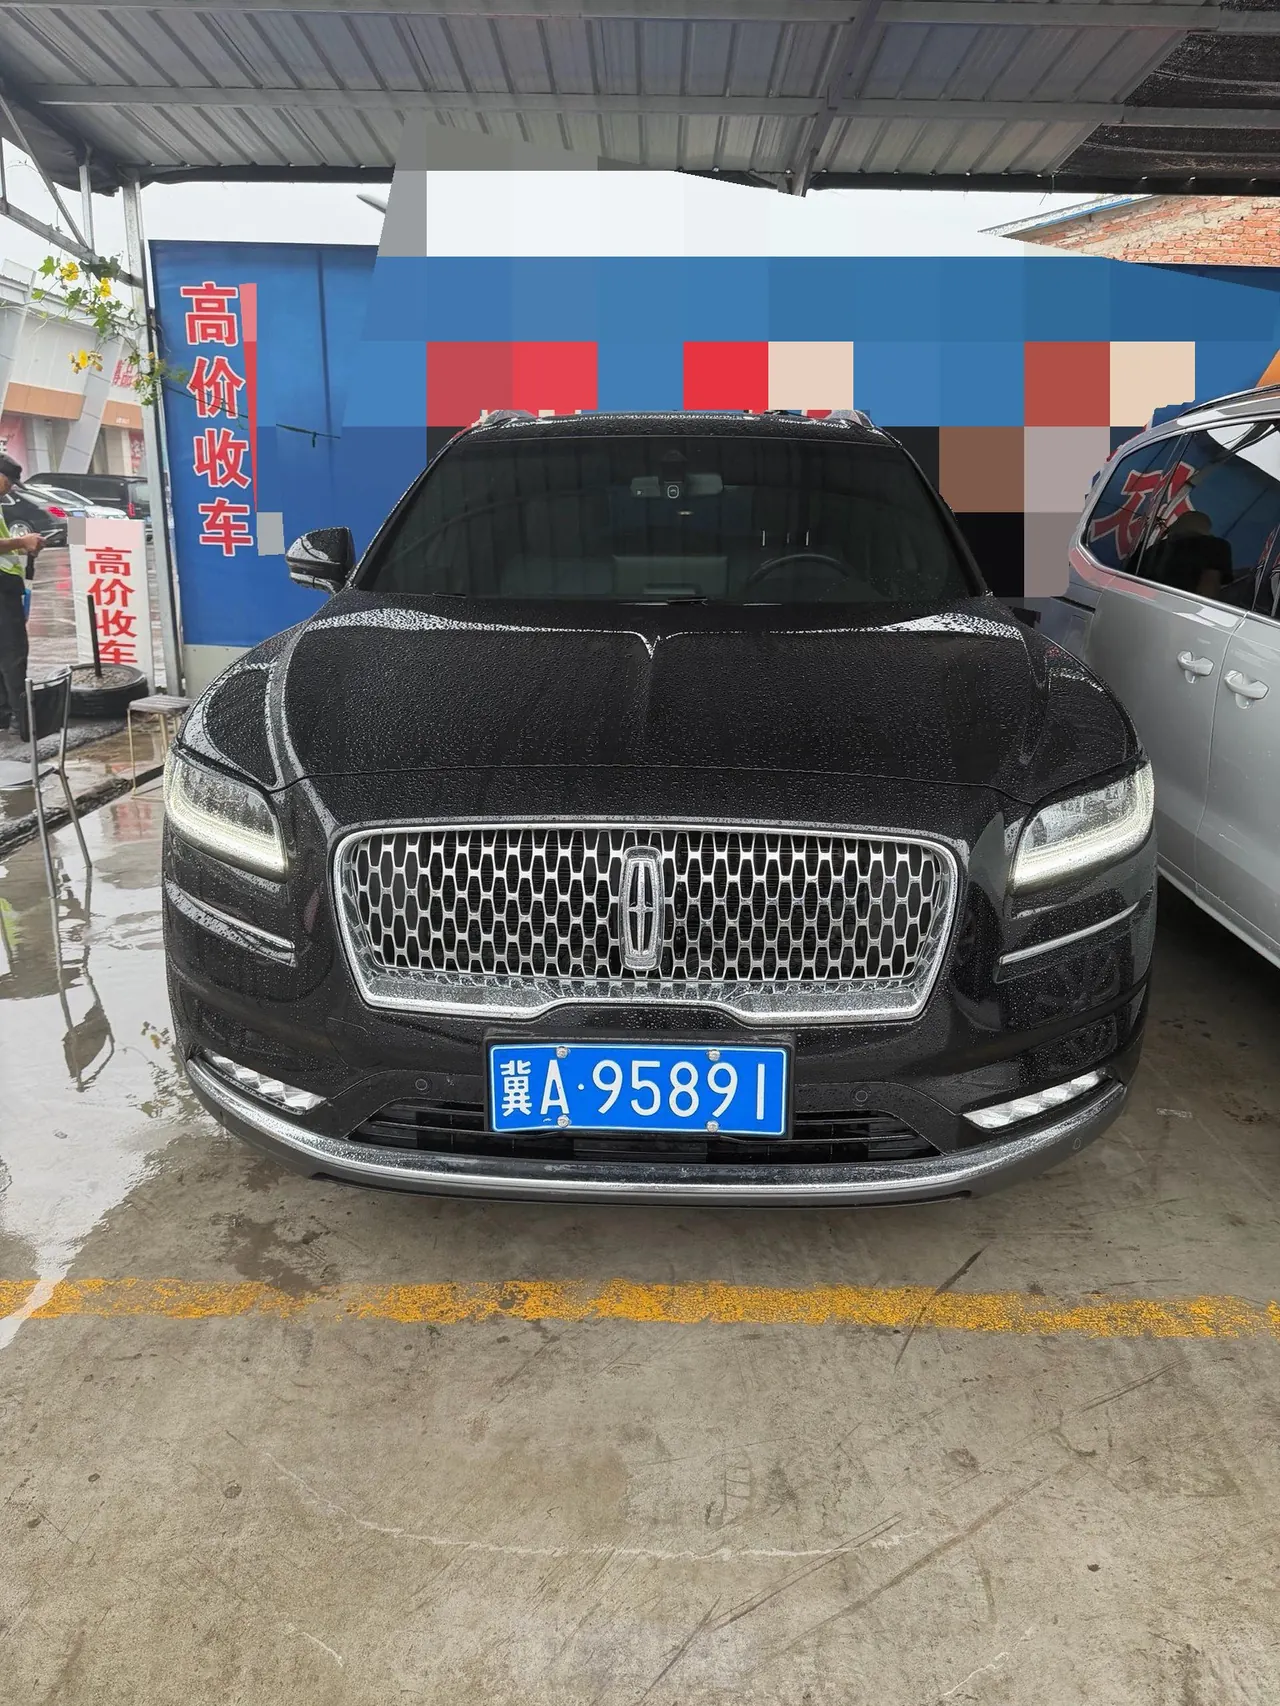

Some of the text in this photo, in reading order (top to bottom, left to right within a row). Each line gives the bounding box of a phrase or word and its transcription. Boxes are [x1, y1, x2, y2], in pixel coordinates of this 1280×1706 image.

[181, 281, 253, 557] 高价收车
[85, 546, 138, 664] 高价收车
